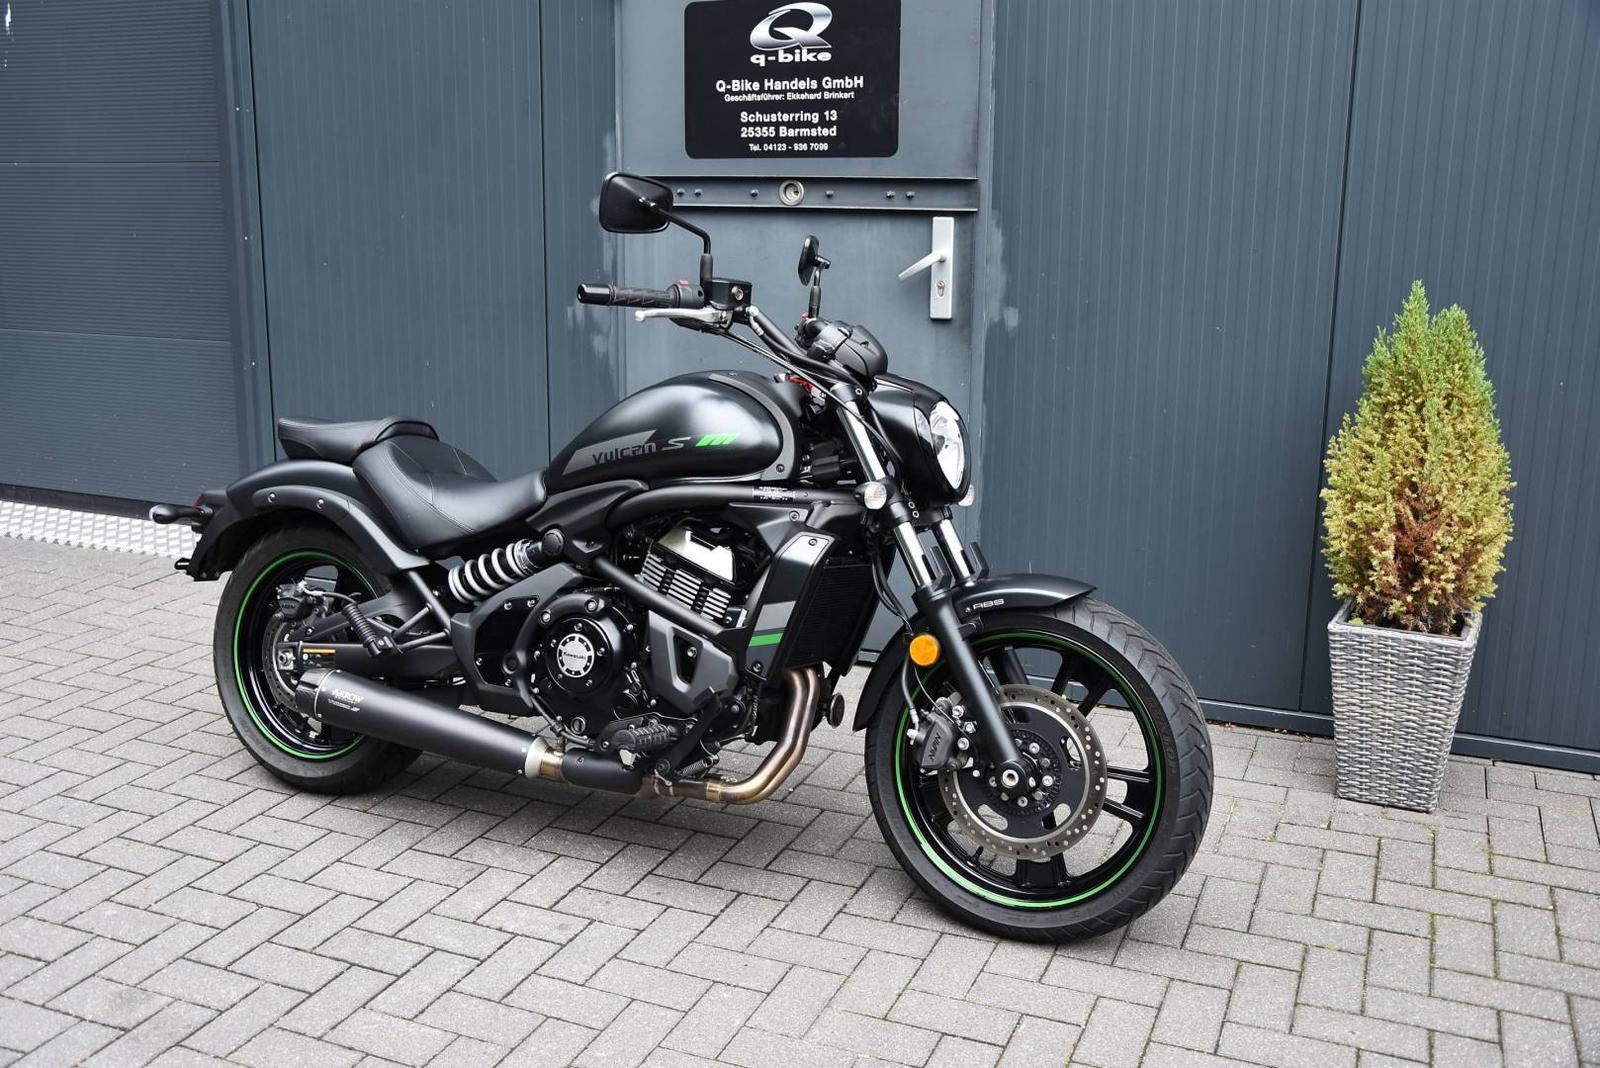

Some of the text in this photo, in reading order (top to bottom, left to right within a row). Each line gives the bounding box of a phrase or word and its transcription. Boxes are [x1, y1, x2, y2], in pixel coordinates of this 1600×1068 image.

[750, 49, 832, 66] q-bike
[715, 76, 864, 92] Q-Bike Handels GmbH
[724, 91, 855, 102] Geschäftsführer: Ekkehard Brinkert
[740, 110, 838, 123] Schusterring 13
[740, 126, 837, 137] 25355 Barmsted
[793, 143, 808, 151] 936
[809, 143, 829, 151] 7099
[662, 436, 692, 451] S
[972, 598, 1005, 610] ABS
